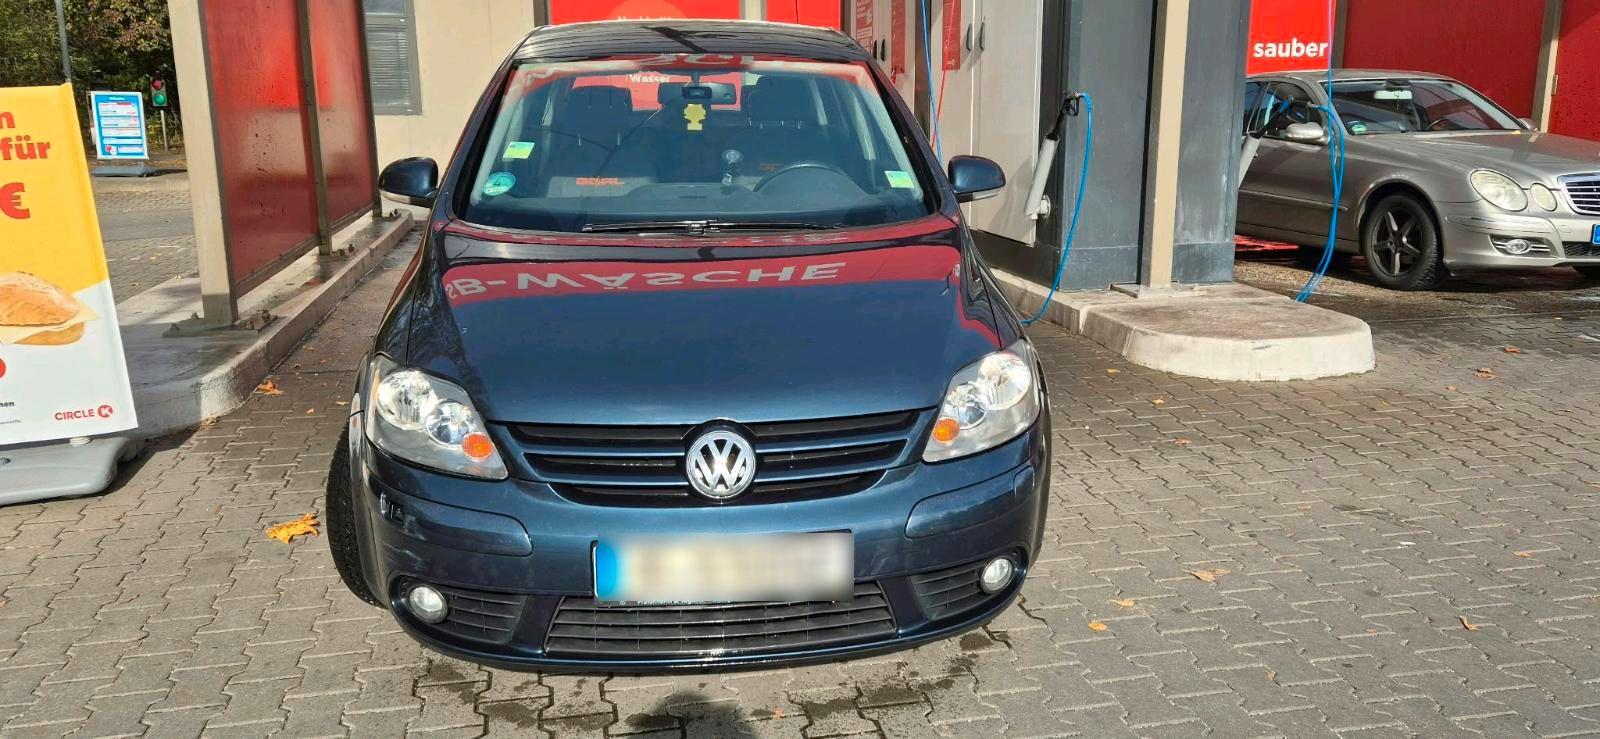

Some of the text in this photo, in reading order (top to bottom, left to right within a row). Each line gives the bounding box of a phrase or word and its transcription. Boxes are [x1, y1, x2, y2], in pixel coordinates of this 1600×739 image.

[1253, 37, 1328, 57] sauber
[628, 73, 670, 83] Wasser
[0, 134, 51, 160] für
[54, 405, 113, 421] CIRCLE K
[687, 431, 756, 498] VW
